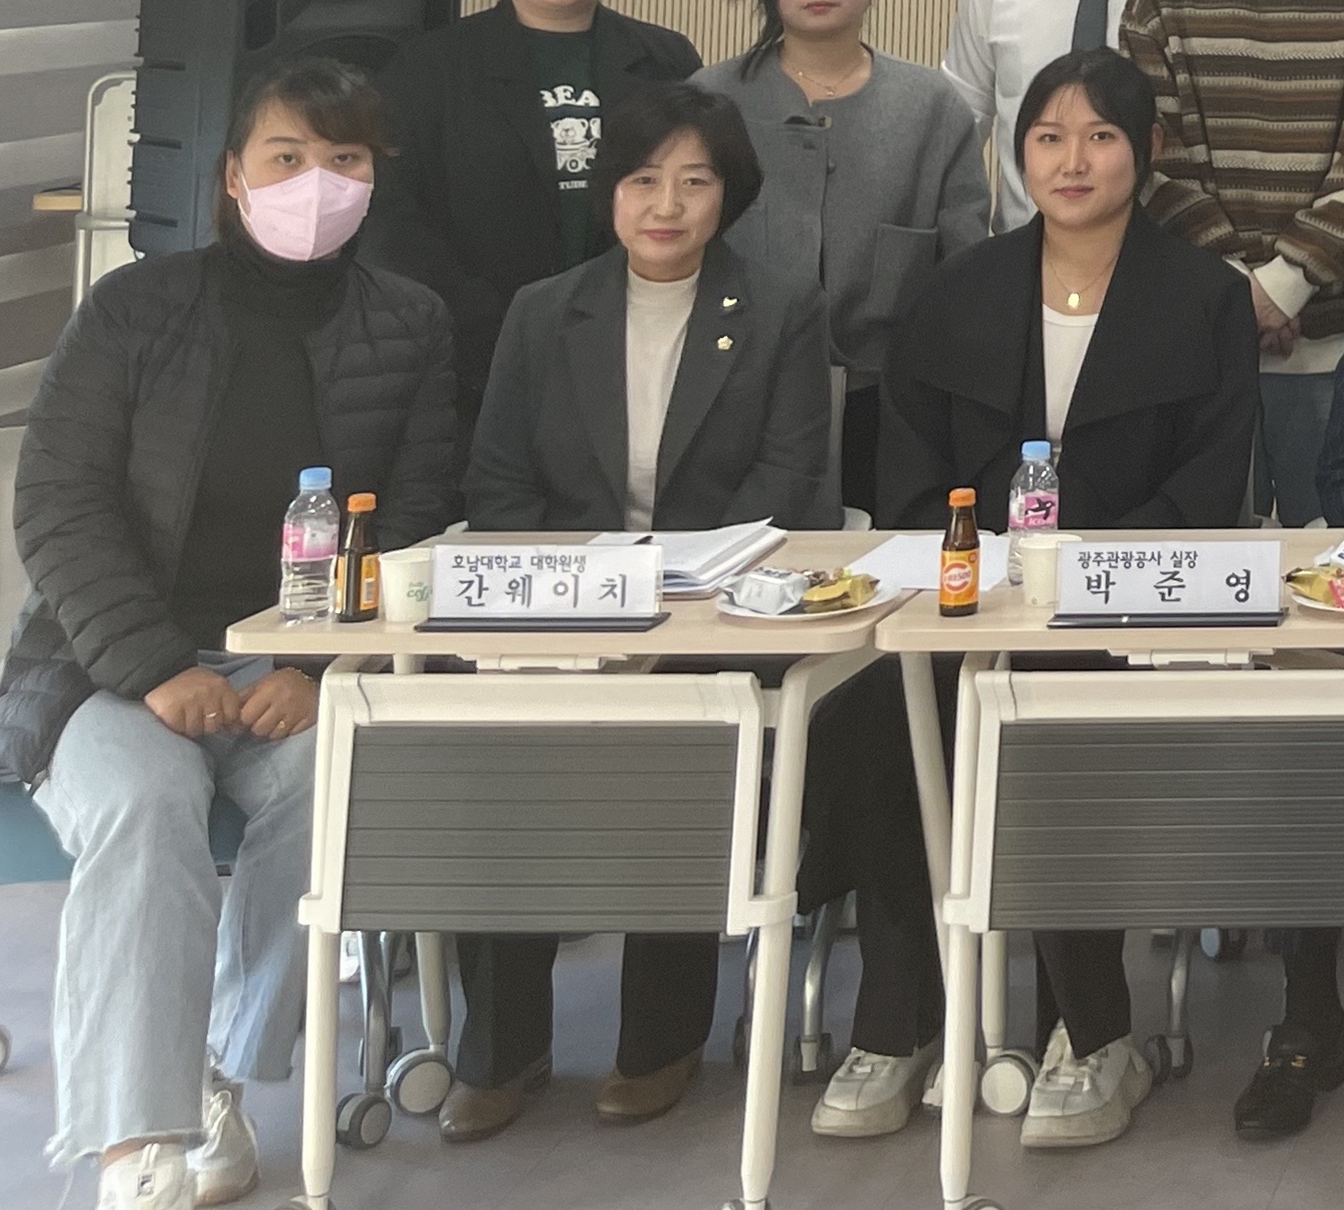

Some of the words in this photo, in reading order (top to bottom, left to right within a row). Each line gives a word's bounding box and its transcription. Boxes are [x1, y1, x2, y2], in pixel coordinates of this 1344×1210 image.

[452, 555, 522, 573] 호남대학교
[530, 555, 587, 573] 대학원생
[1077, 551, 1163, 573] 광주관광공사
[1169, 551, 1199, 571] 실장
